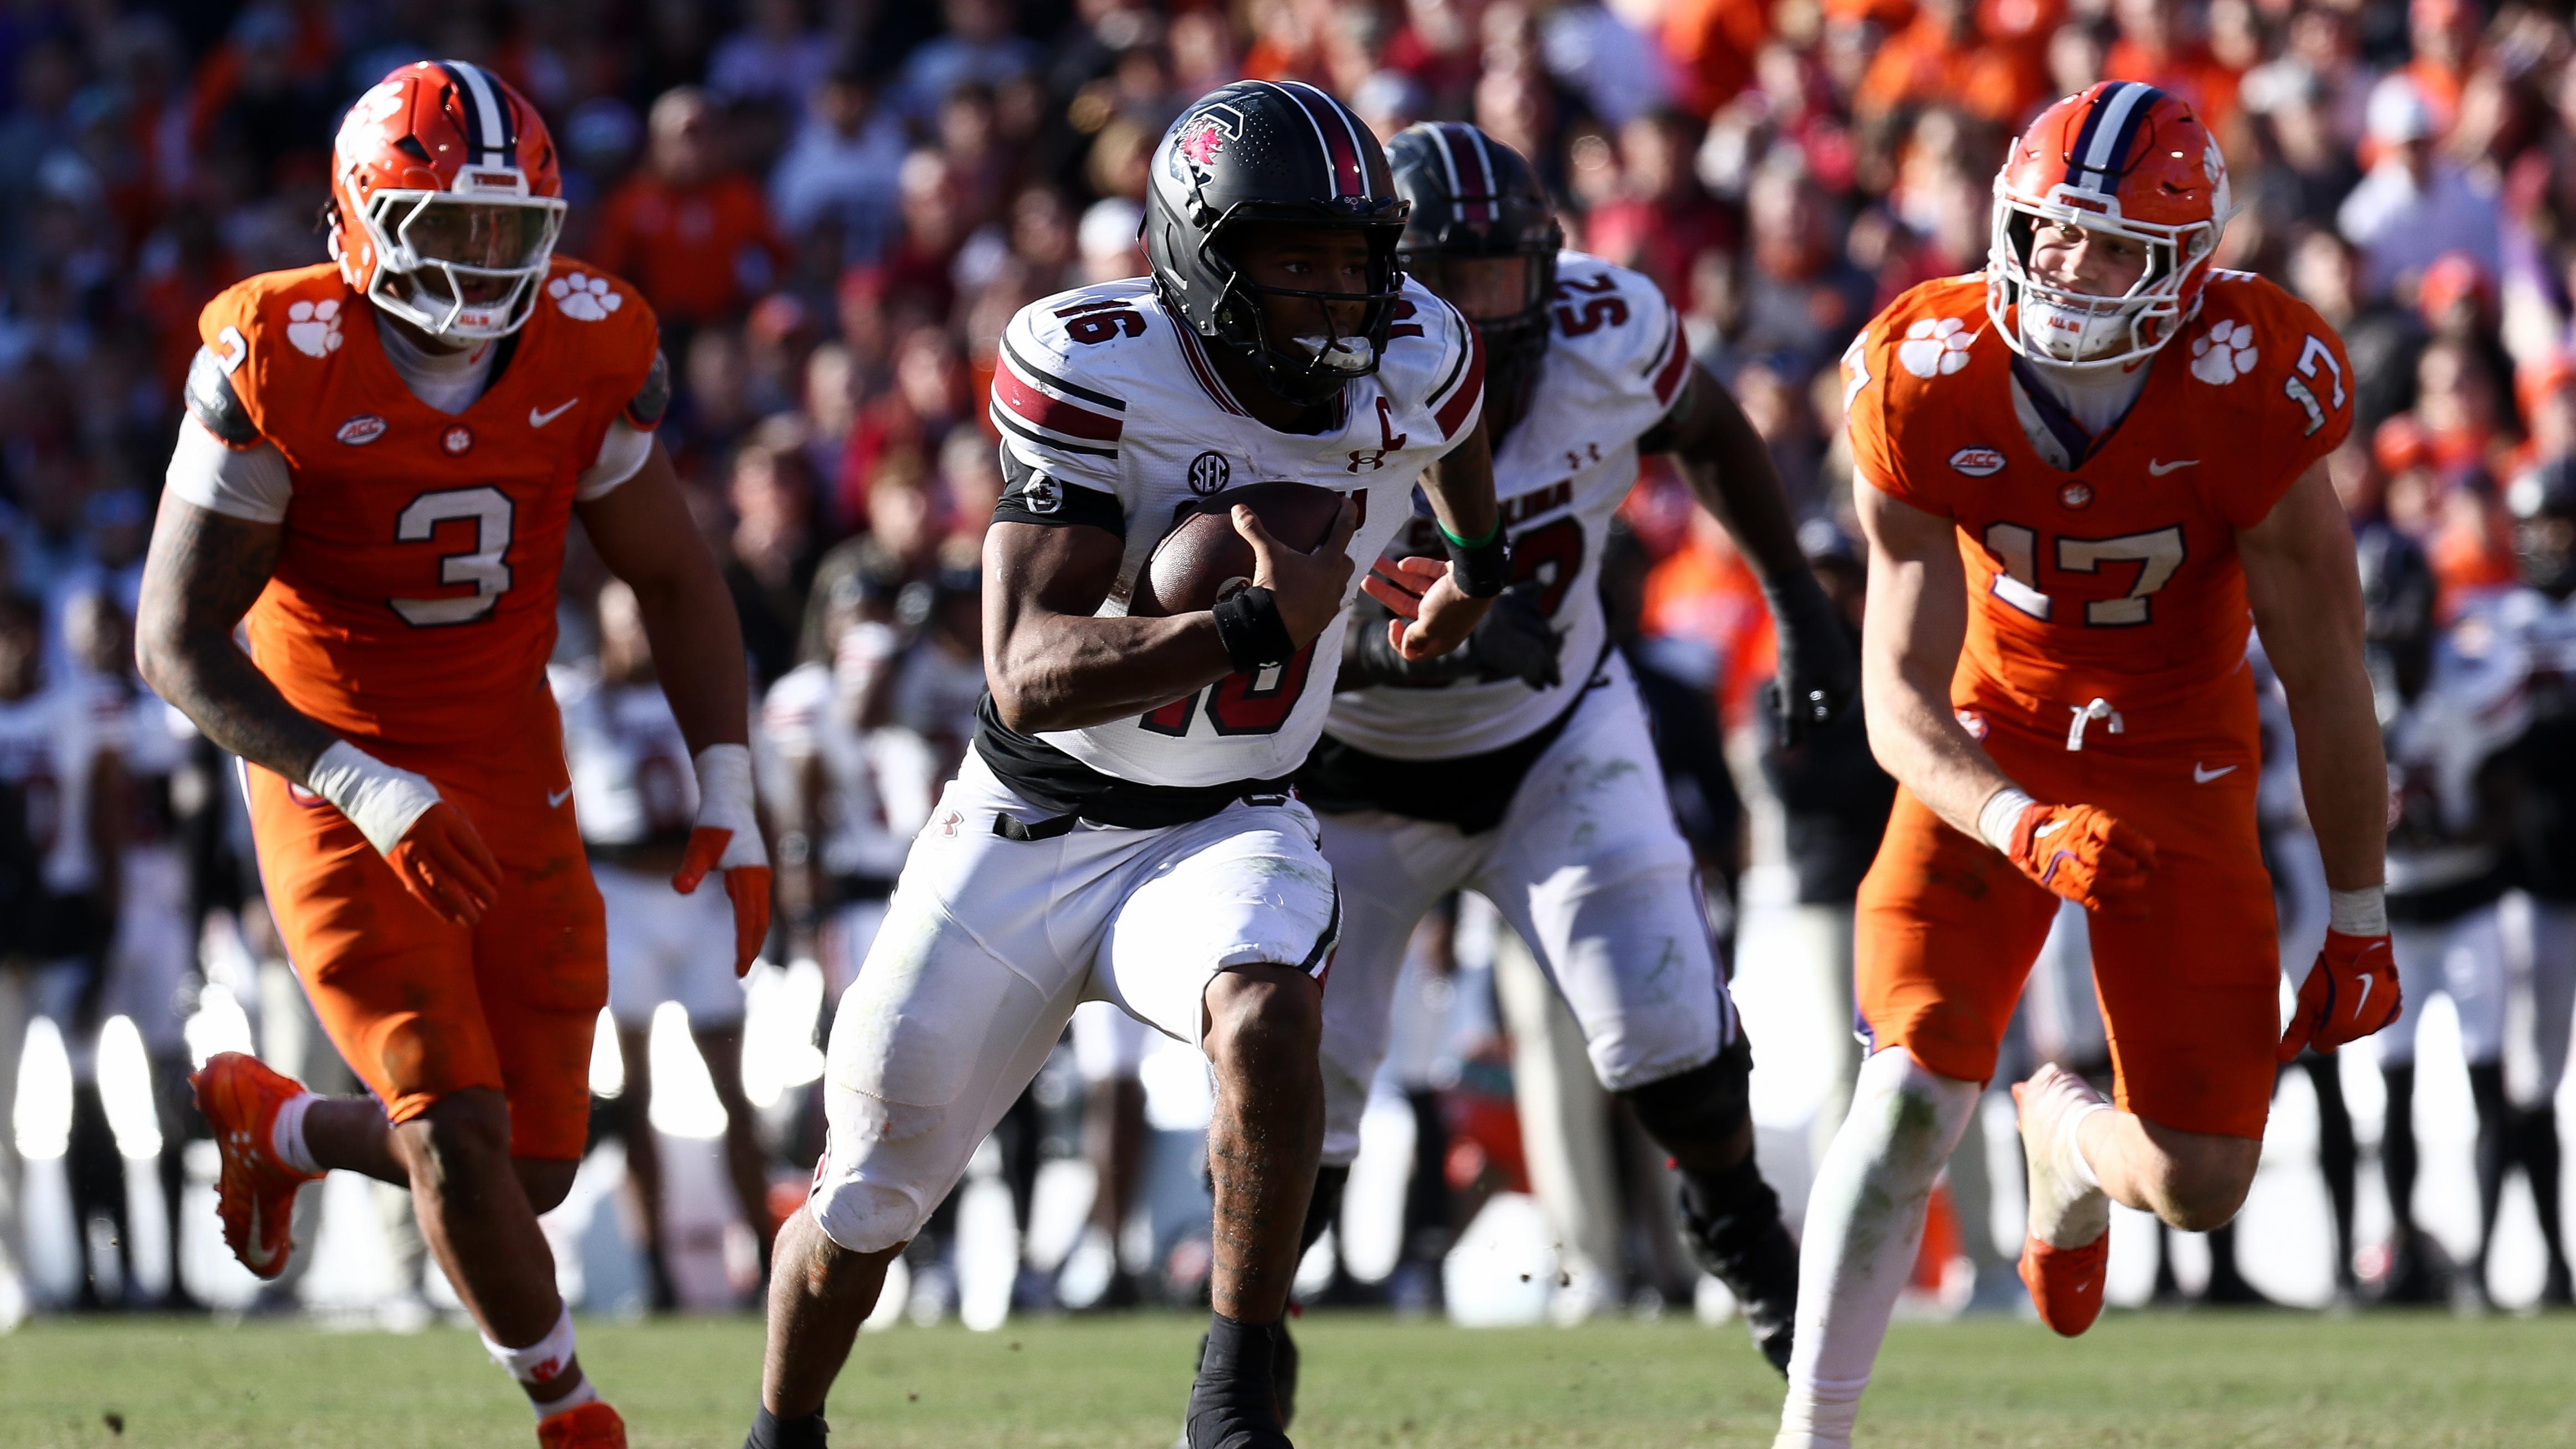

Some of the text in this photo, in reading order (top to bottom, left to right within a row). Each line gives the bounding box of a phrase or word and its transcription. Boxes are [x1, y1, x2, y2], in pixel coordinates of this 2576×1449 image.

[1053, 299, 1148, 346] 16
[1554, 271, 1631, 339] 52
[2048, 315, 2080, 333] ALL IN
[2283, 332, 2347, 438] 17
[345, 419, 380, 438] ACC
[1193, 455, 1226, 492] SEC
[1956, 453, 2002, 466] ACC
[385, 484, 516, 629] 3
[1983, 519, 2188, 628] 17
